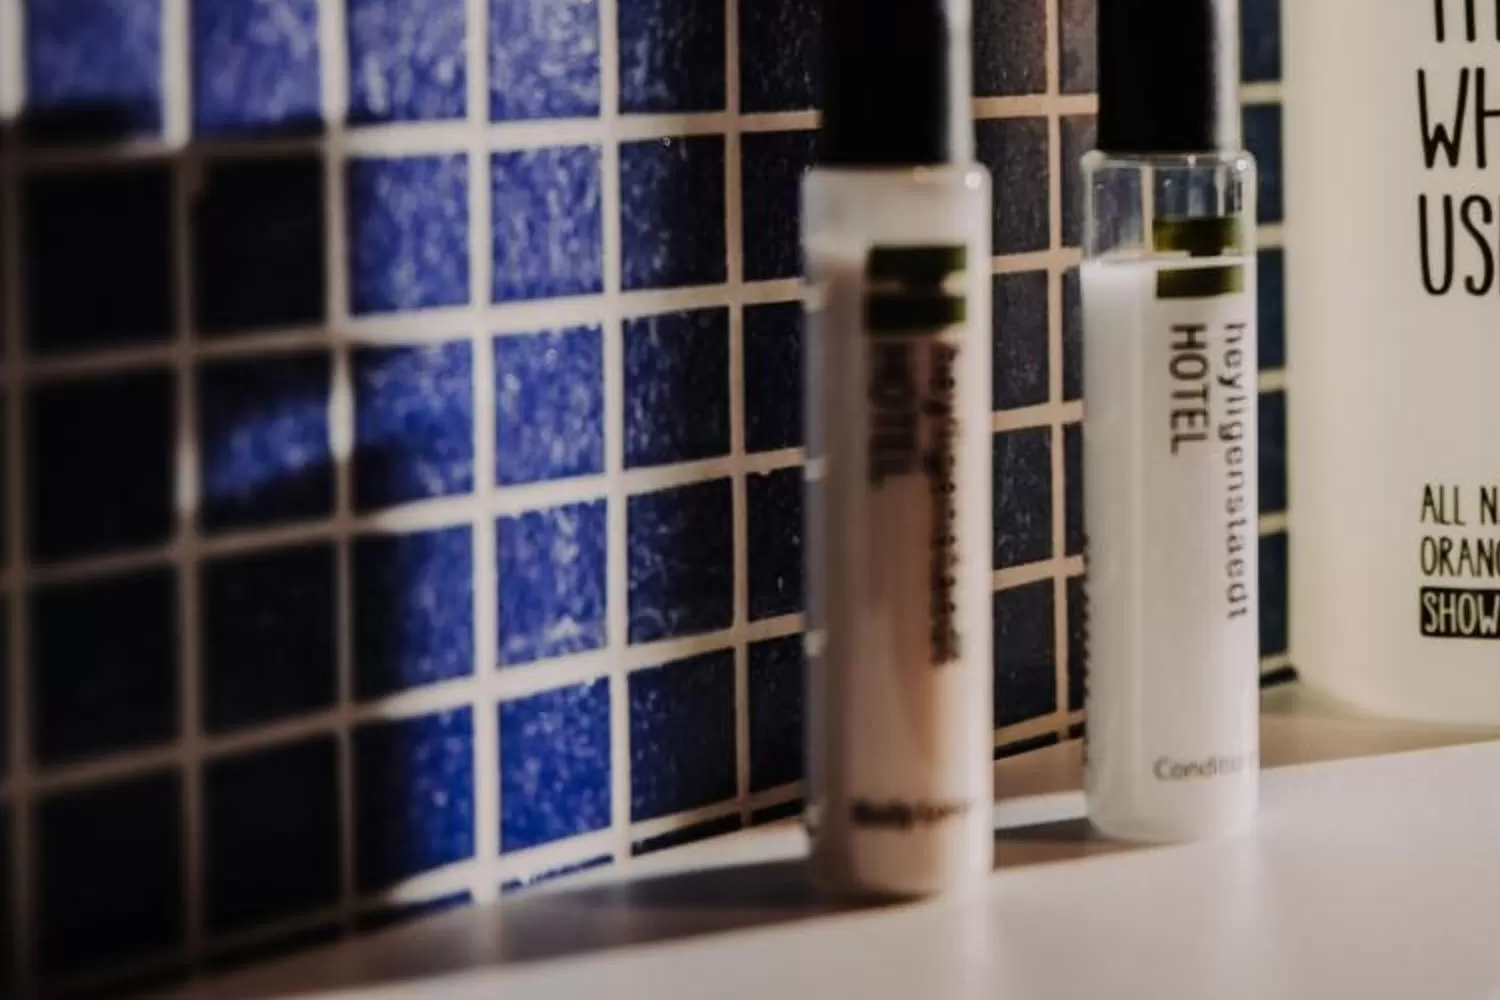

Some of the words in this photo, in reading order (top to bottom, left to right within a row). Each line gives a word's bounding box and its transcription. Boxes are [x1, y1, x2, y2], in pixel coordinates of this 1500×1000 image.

[1169, 322, 1210, 457] HOTEL
[1216, 322, 1249, 621] heyligenstaedt
[1420, 483, 1467, 526] ALL
